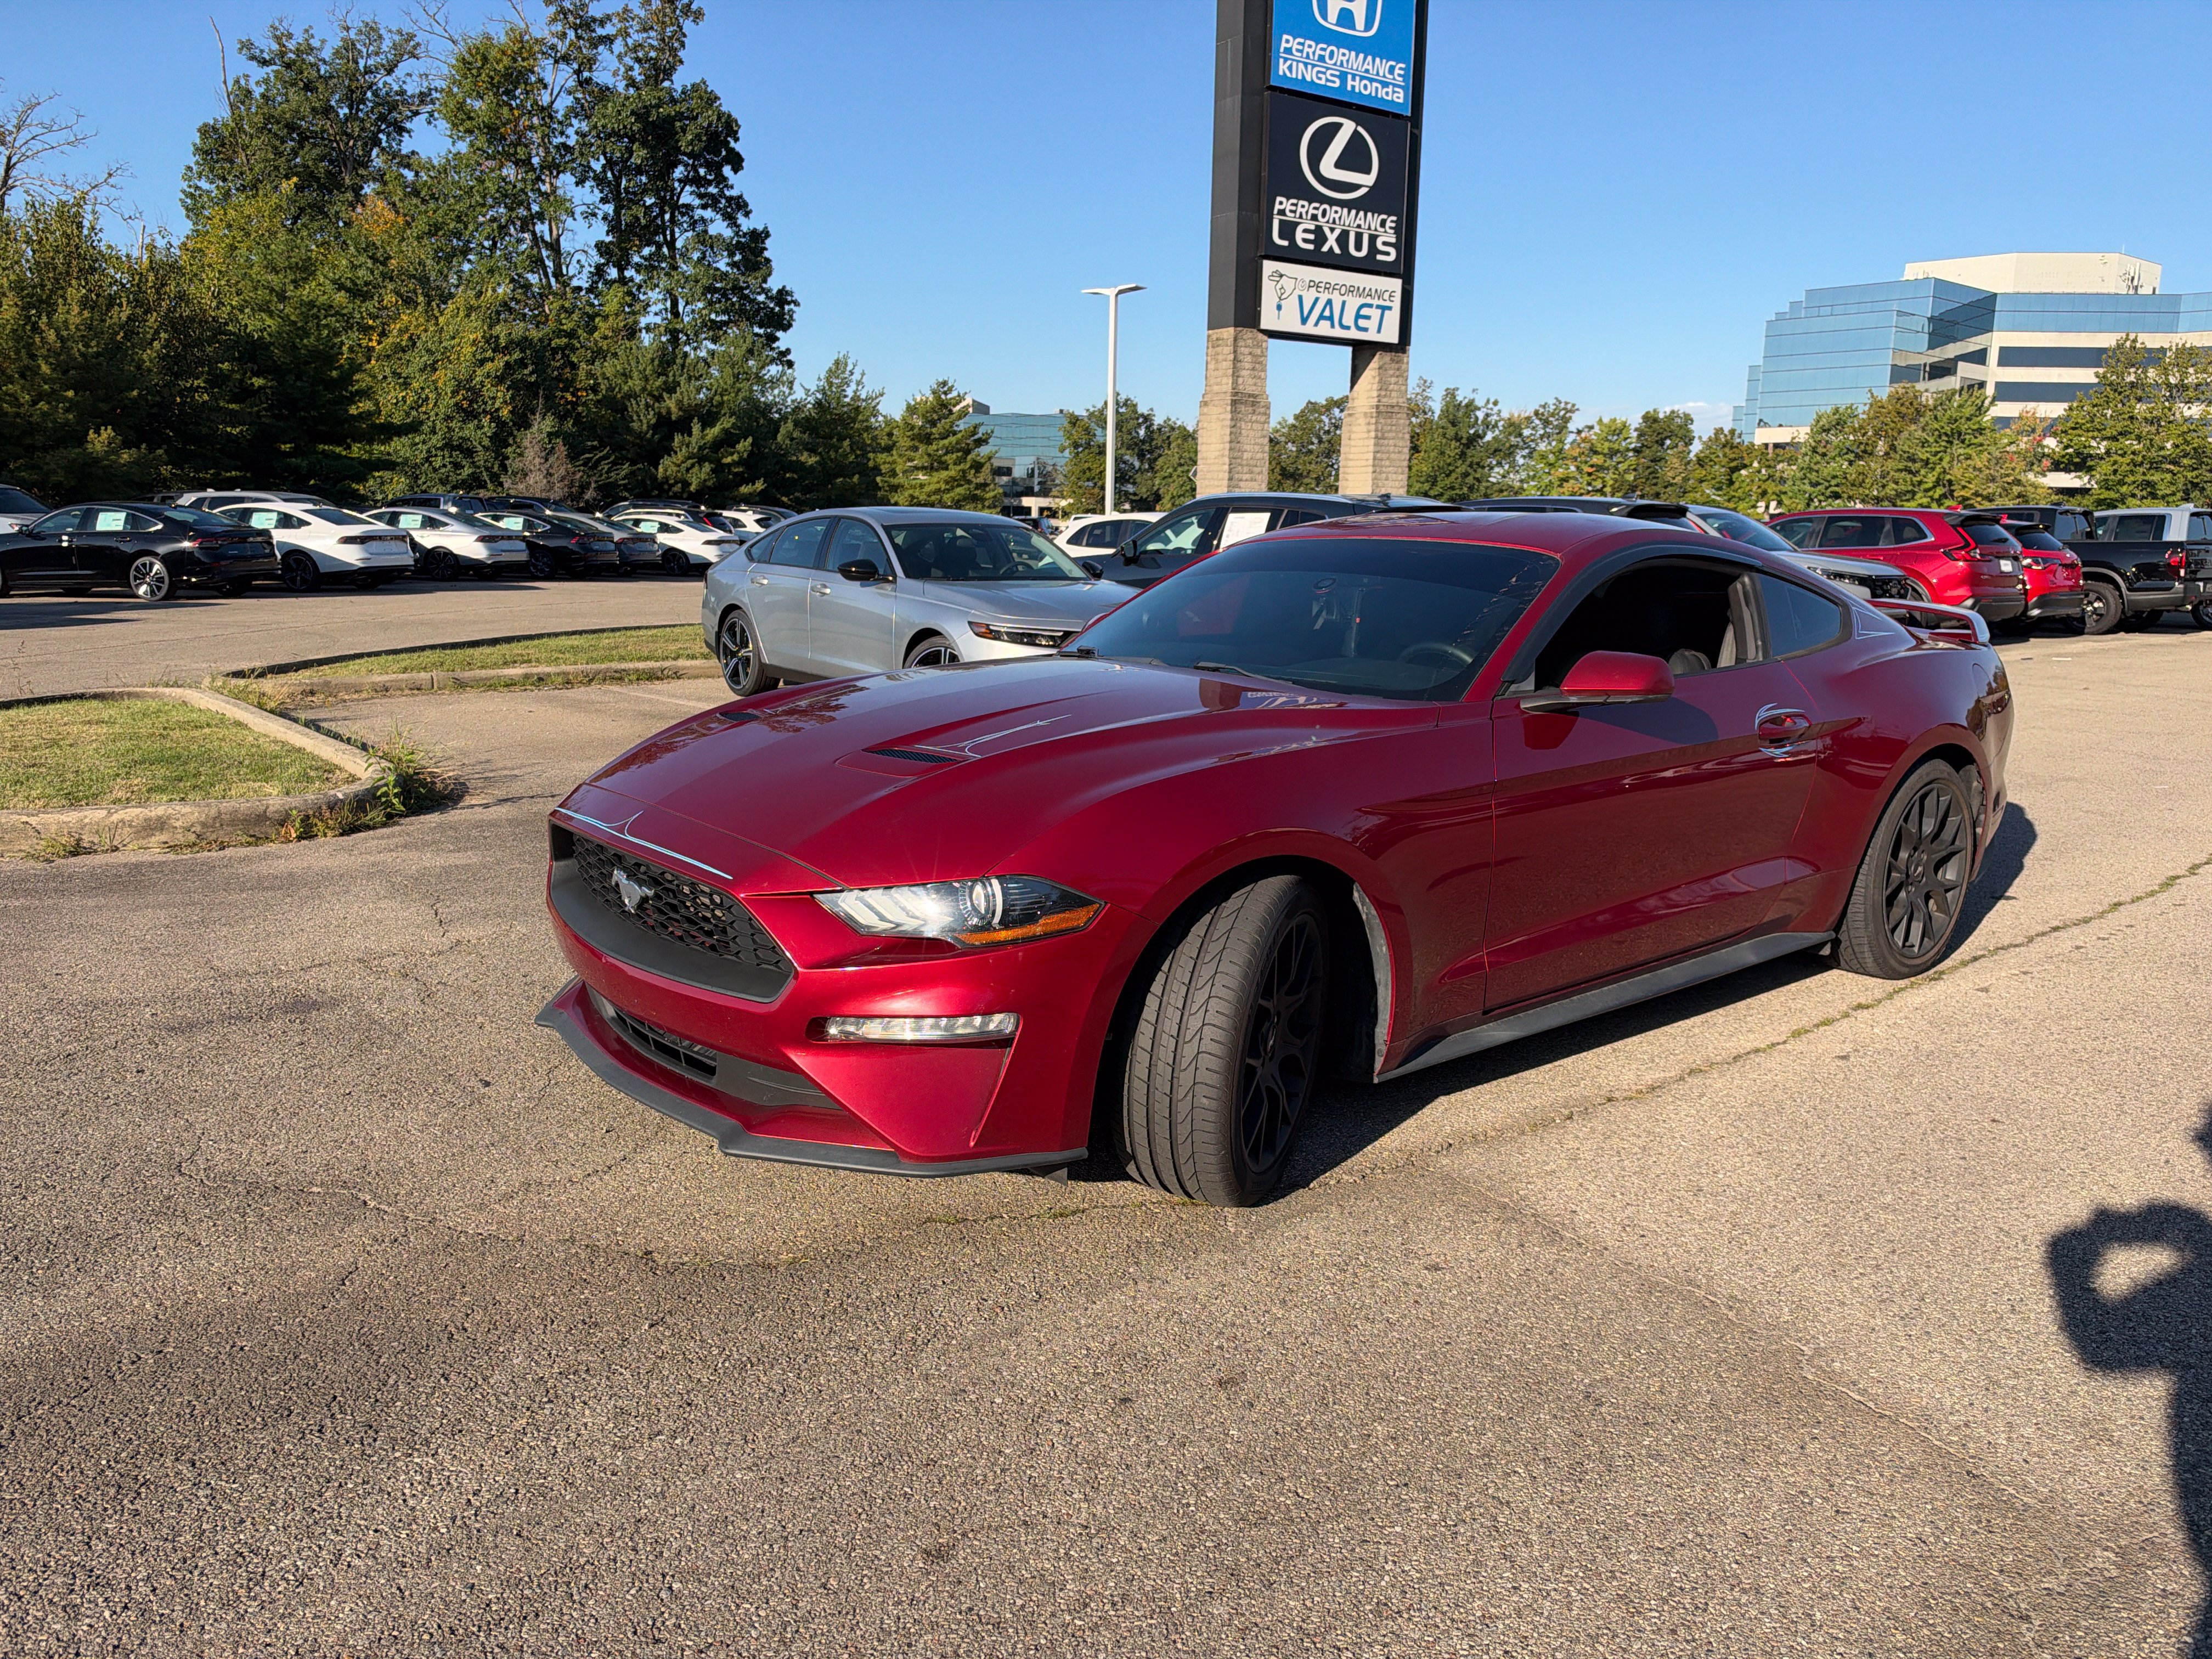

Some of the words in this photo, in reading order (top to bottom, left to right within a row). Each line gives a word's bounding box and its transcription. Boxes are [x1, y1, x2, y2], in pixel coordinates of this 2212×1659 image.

[1280, 34, 1405, 81] PERFORMANCE
[1279, 58, 1340, 88] KINGS
[1347, 75, 1404, 103] Honda
[1273, 196, 1397, 234] PERFORMANCE
[1272, 218, 1397, 262] LEXUS
[1306, 280, 1396, 302] PERFORMANCE
[1297, 294, 1393, 334] VALET
